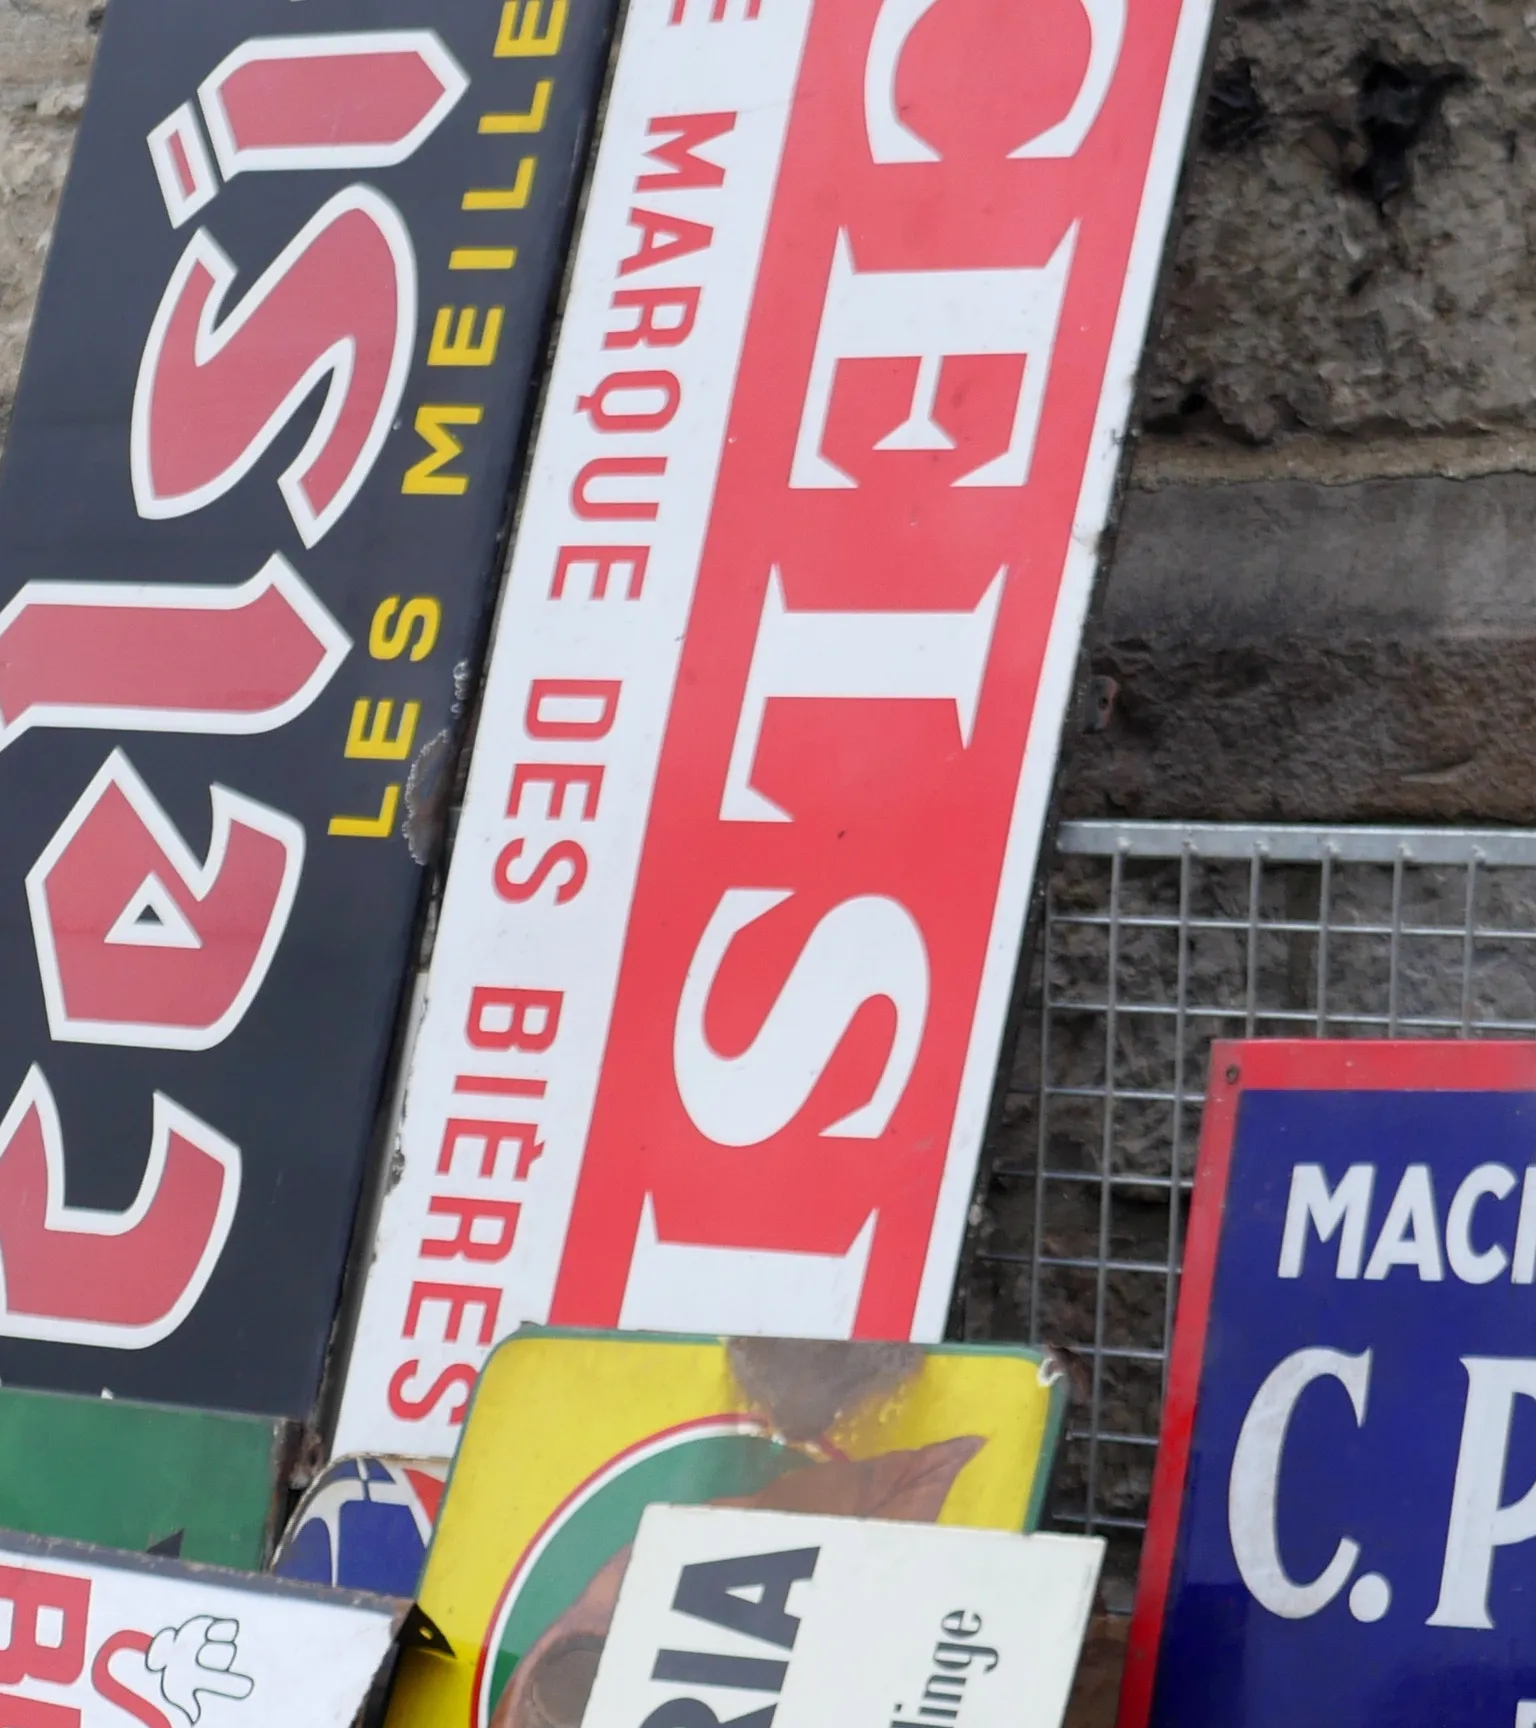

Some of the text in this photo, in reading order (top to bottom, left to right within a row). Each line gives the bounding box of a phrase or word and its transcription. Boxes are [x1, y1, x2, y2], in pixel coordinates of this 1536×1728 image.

[549, 110, 740, 602] MARQUE
[329, 594, 442, 839] LES
[490, 677, 624, 906] DES
[386, 984, 566, 1427] BIÈRES
[1229, 1346, 1389, 1623] C.
